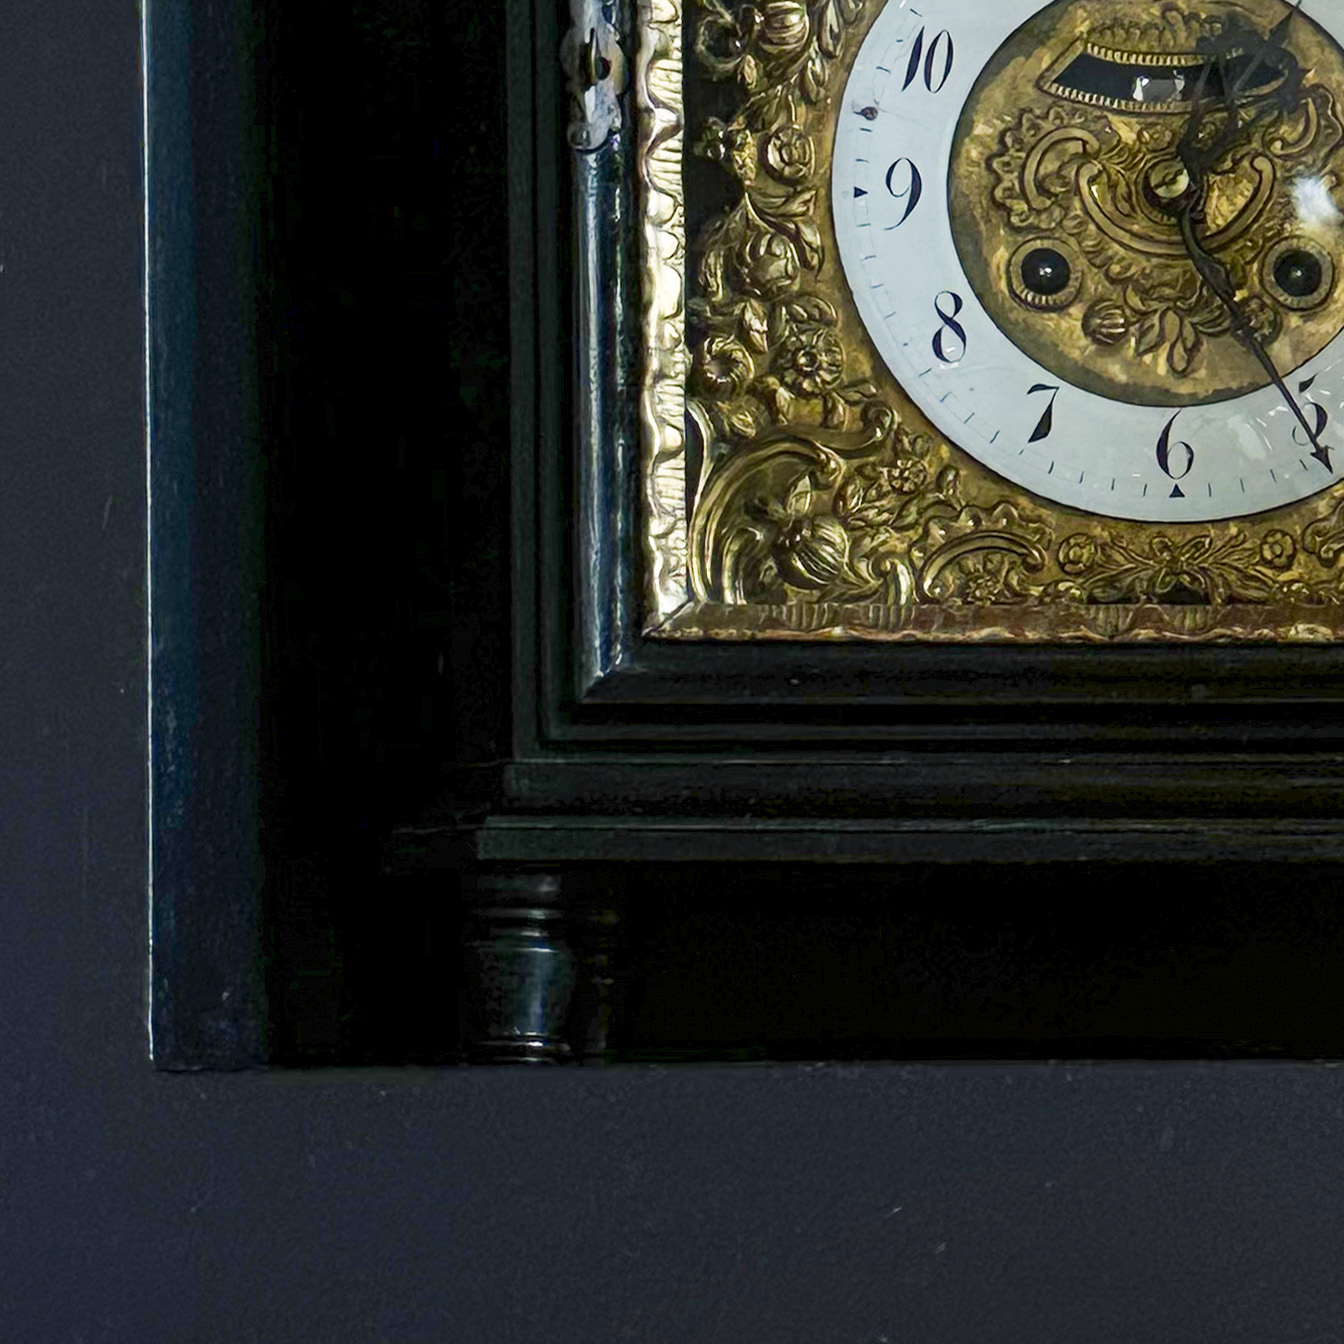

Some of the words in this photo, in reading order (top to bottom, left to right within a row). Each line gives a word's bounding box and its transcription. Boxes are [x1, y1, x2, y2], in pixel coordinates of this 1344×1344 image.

[902, 25, 955, 93] 10
[884, 157, 922, 231] 9
[931, 290, 967, 363] 8
[1027, 384, 1060, 443] 7
[1156, 407, 1194, 479] 6
[1291, 372, 1328, 446] 5
